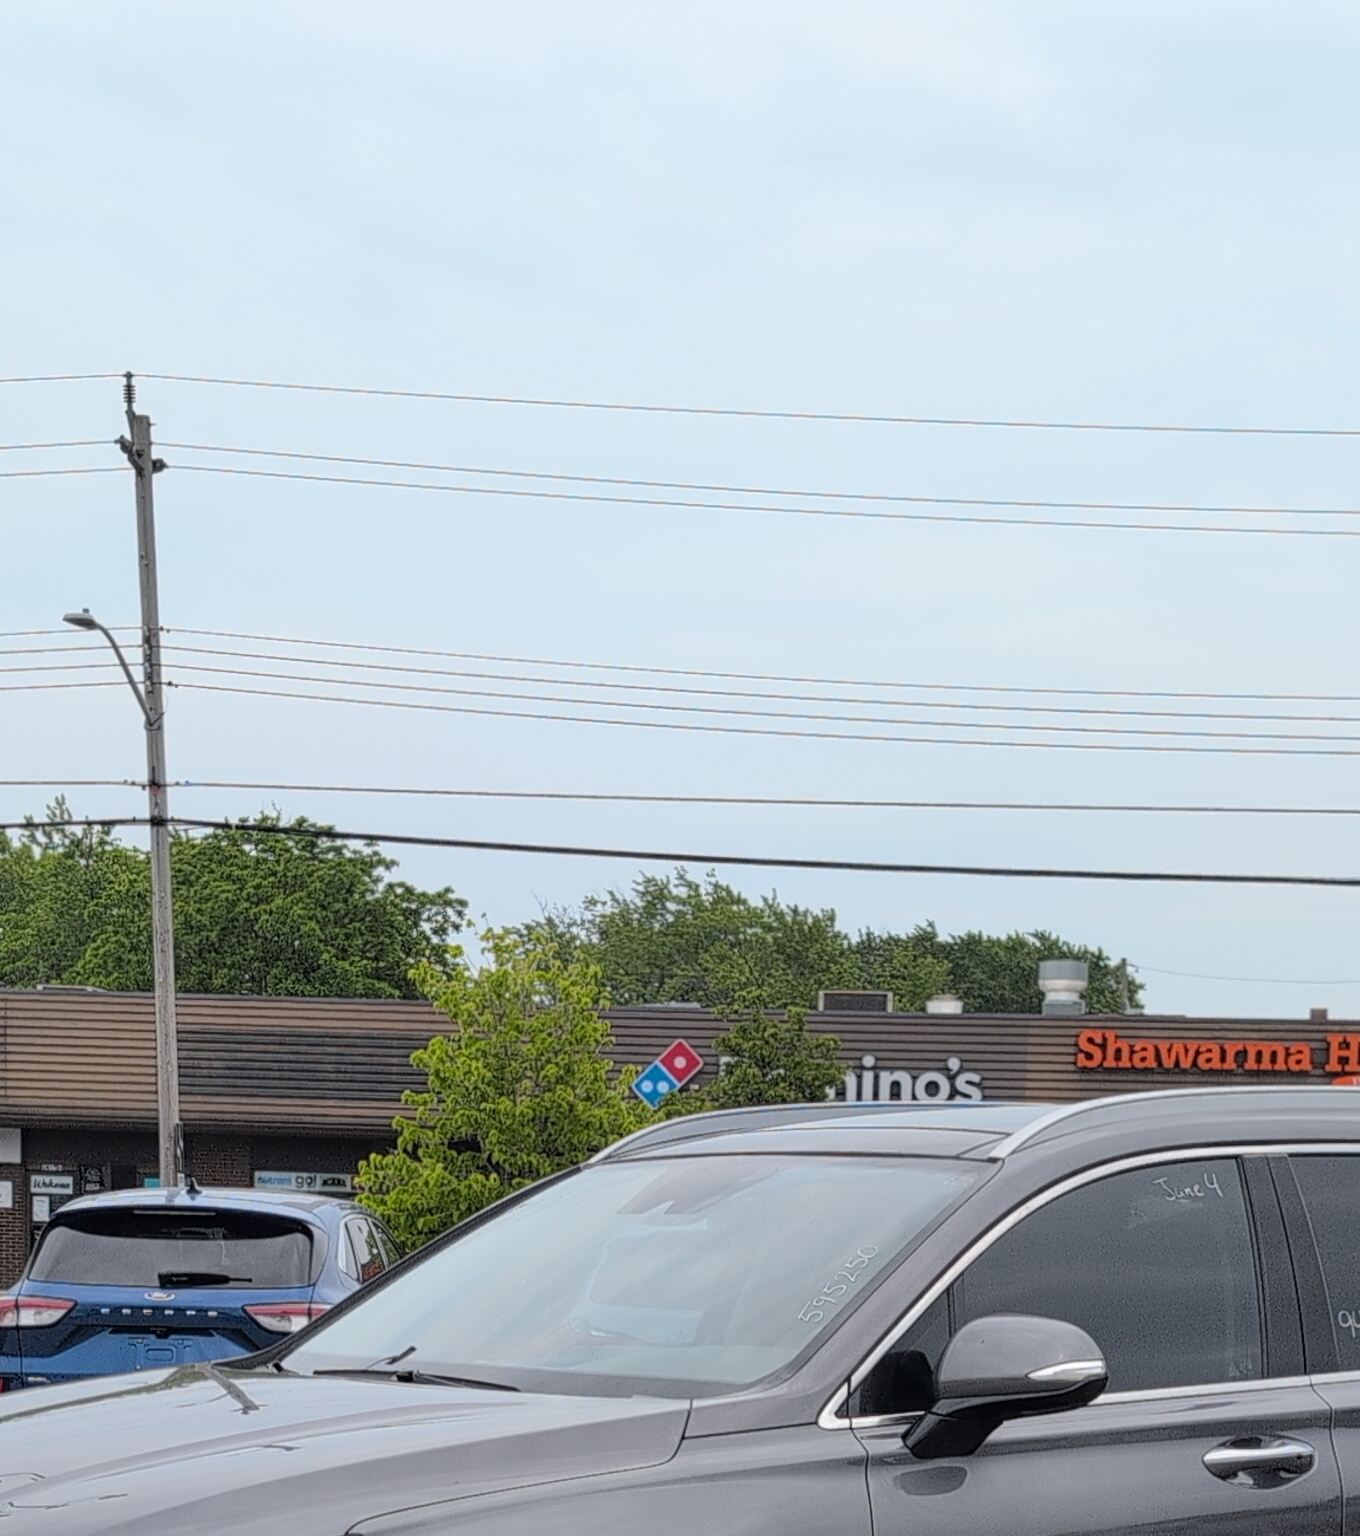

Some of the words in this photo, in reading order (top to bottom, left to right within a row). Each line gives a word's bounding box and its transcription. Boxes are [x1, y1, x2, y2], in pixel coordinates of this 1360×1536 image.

[1076, 1030, 1313, 1072] Shawarma
[295, 1174, 317, 1189] go!
[1153, 1177, 1205, 1201] June
[1204, 1172, 1223, 1198] 4
